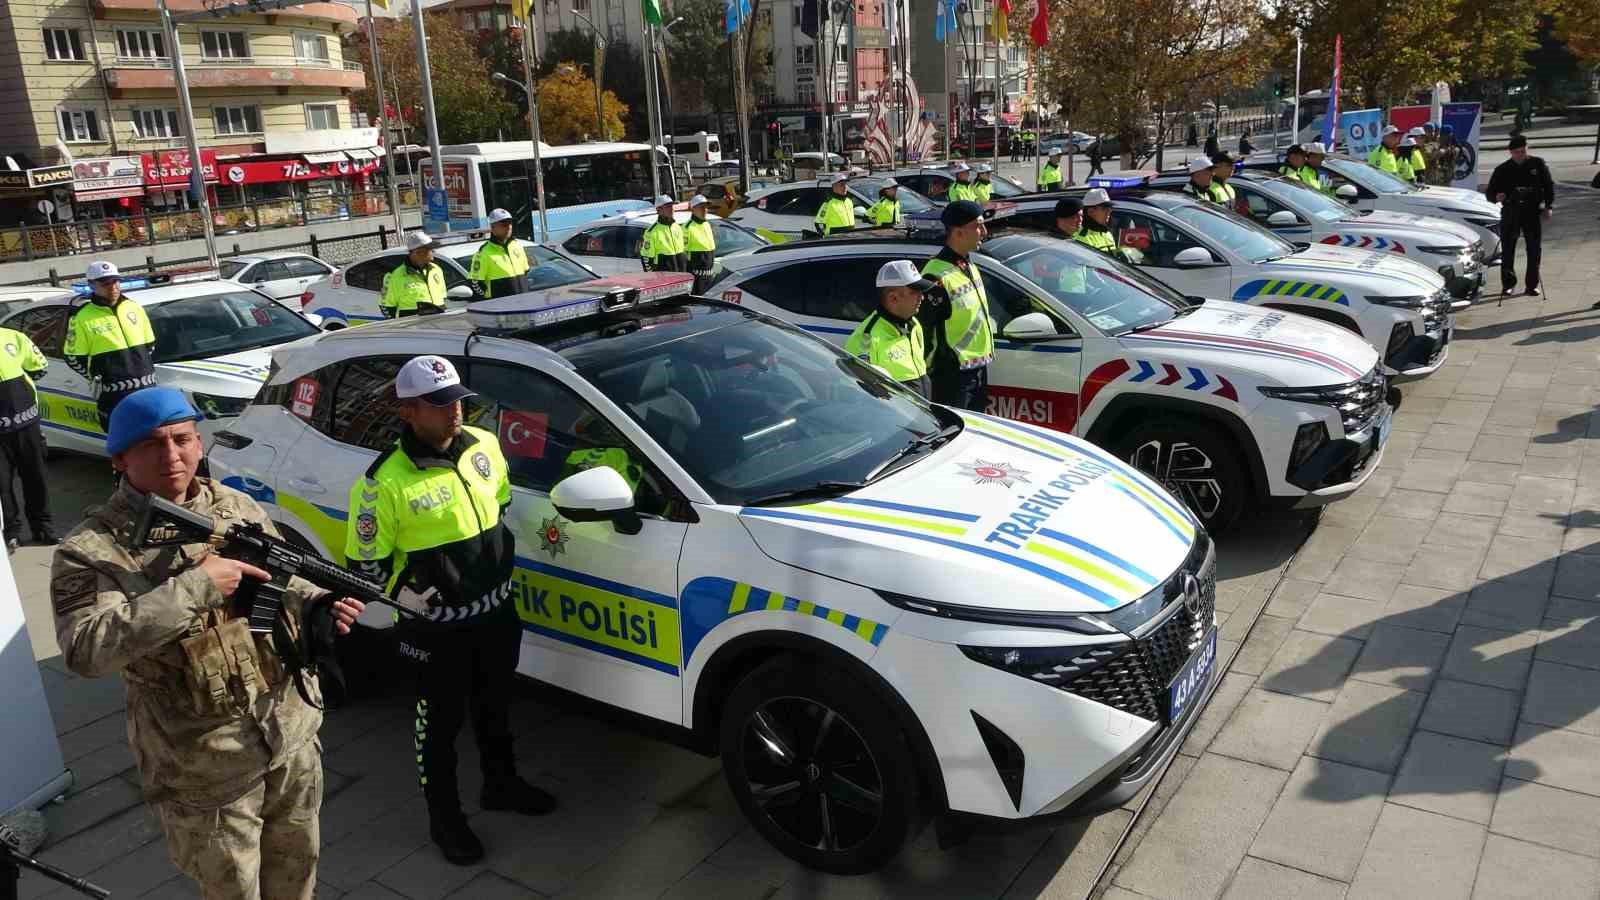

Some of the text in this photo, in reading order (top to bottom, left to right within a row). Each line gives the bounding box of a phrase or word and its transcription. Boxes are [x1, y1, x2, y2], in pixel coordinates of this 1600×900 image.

[299, 383, 314, 402] 112
[409, 486, 452, 515] POLİS
[984, 457, 1112, 550] TRAFİK POLİSİ
[559, 590, 657, 649] POLİSİ
